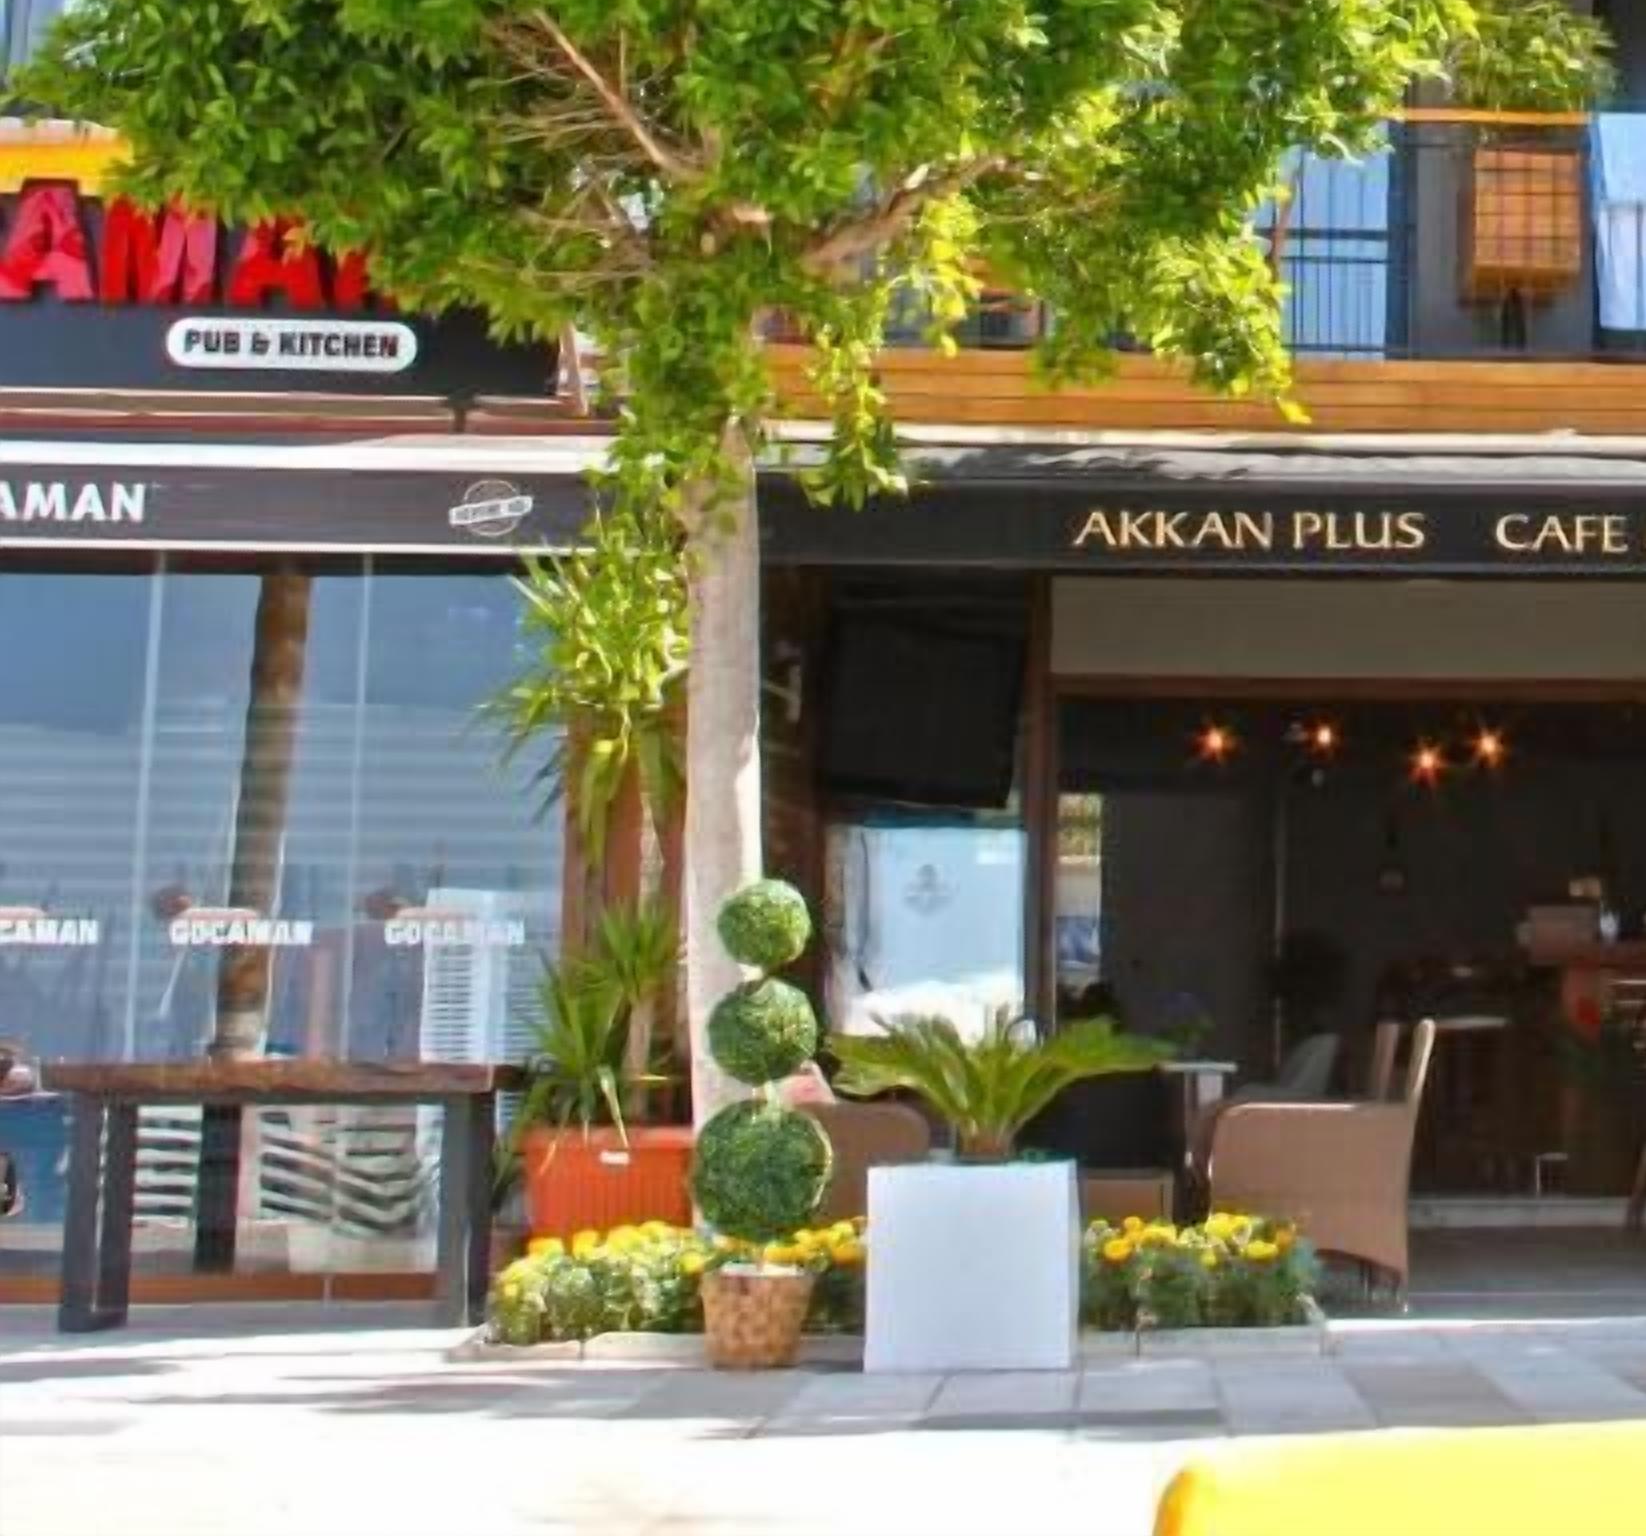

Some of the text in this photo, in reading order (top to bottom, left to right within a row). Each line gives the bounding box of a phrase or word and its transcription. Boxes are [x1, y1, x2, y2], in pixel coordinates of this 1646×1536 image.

[184, 328, 399, 358] PUB & KITCHEN
[1072, 510, 1274, 550] AKKAN
[1292, 511, 1426, 551] PLUS
[1495, 513, 1629, 553] CAFE
